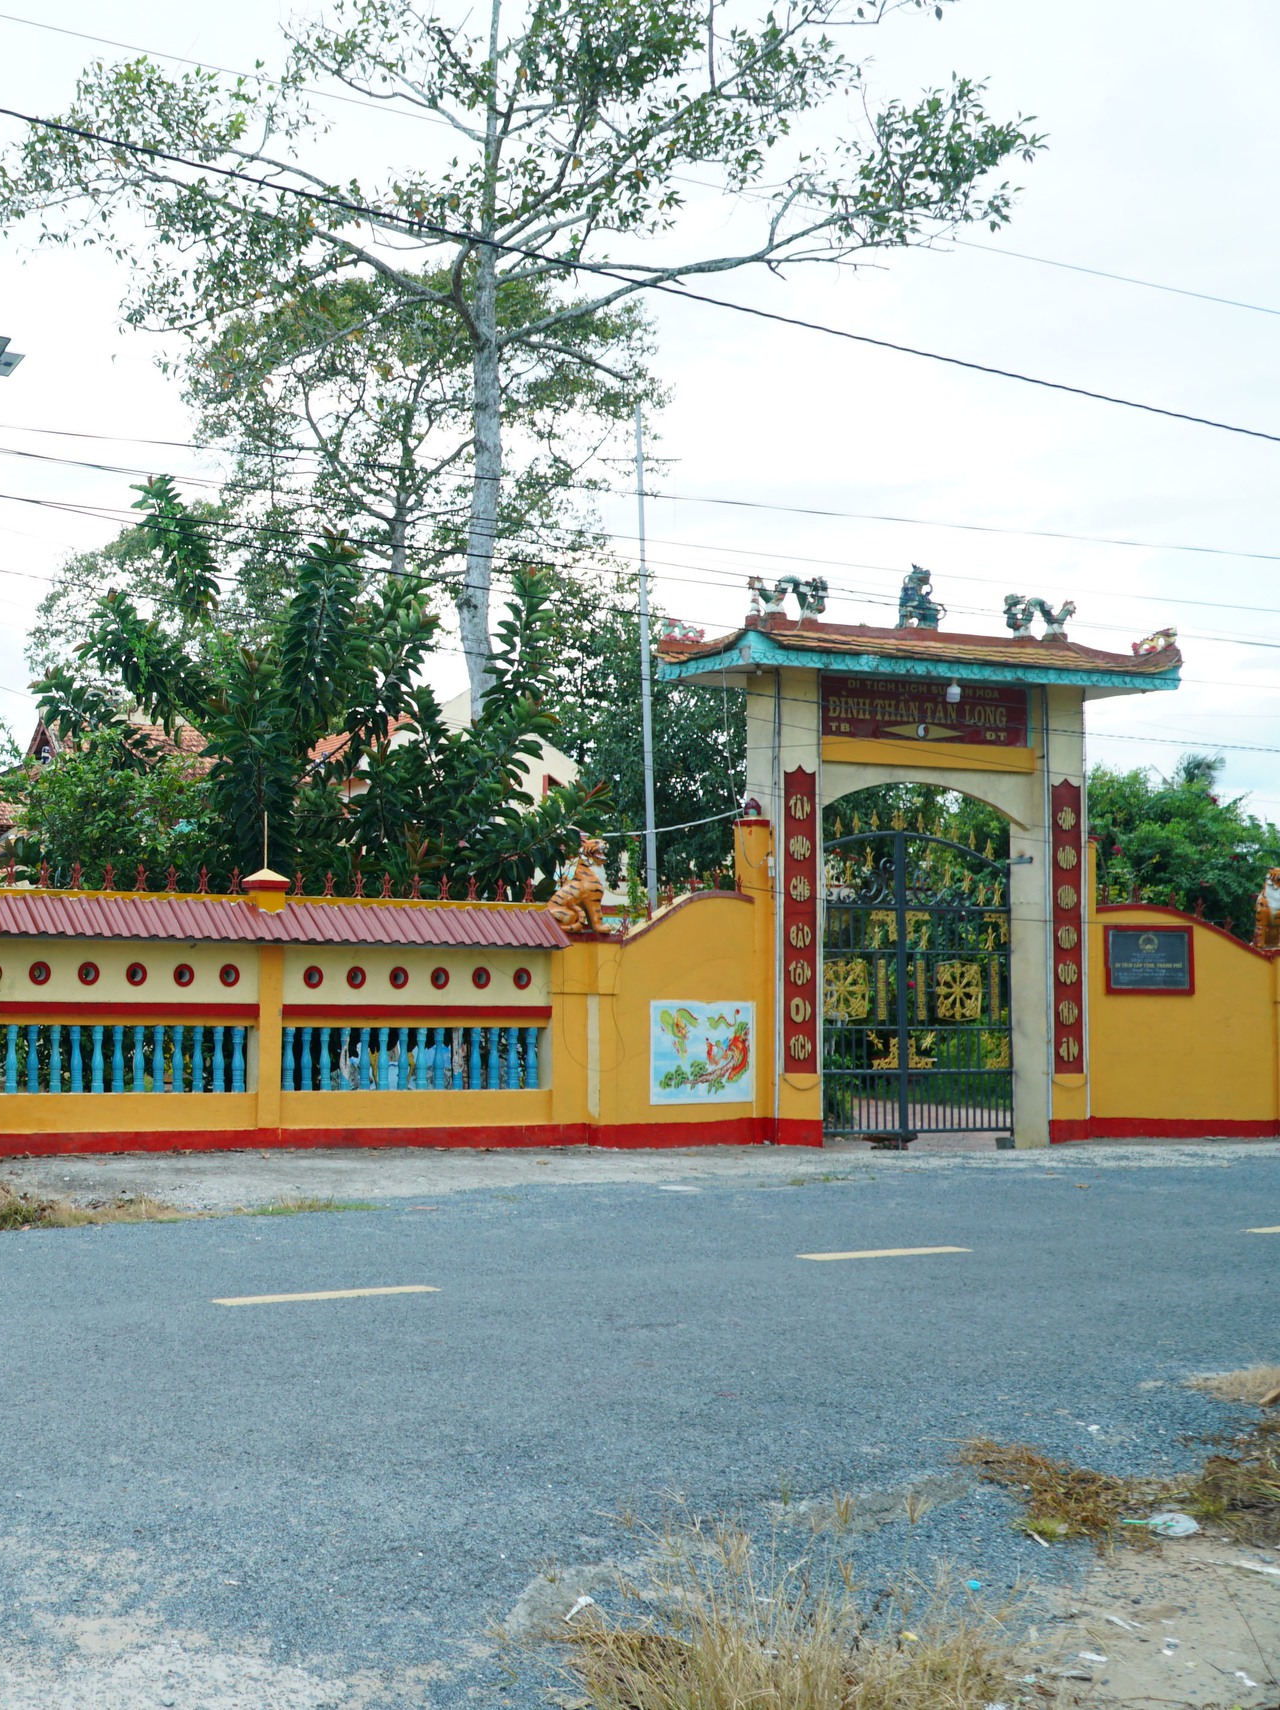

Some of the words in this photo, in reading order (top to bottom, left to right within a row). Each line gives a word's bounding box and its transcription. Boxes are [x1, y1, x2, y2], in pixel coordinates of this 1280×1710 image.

[828, 691, 871, 719] ĐÌNH
[873, 694, 919, 722] THẦN
[924, 697, 957, 724] TÂN
[964, 704, 1008, 728] LONG
[789, 794, 811, 820] TÂN
[789, 834, 811, 861] PHỤC
[789, 923, 811, 948] BẢO
[789, 1034, 811, 1060] TÍCH
